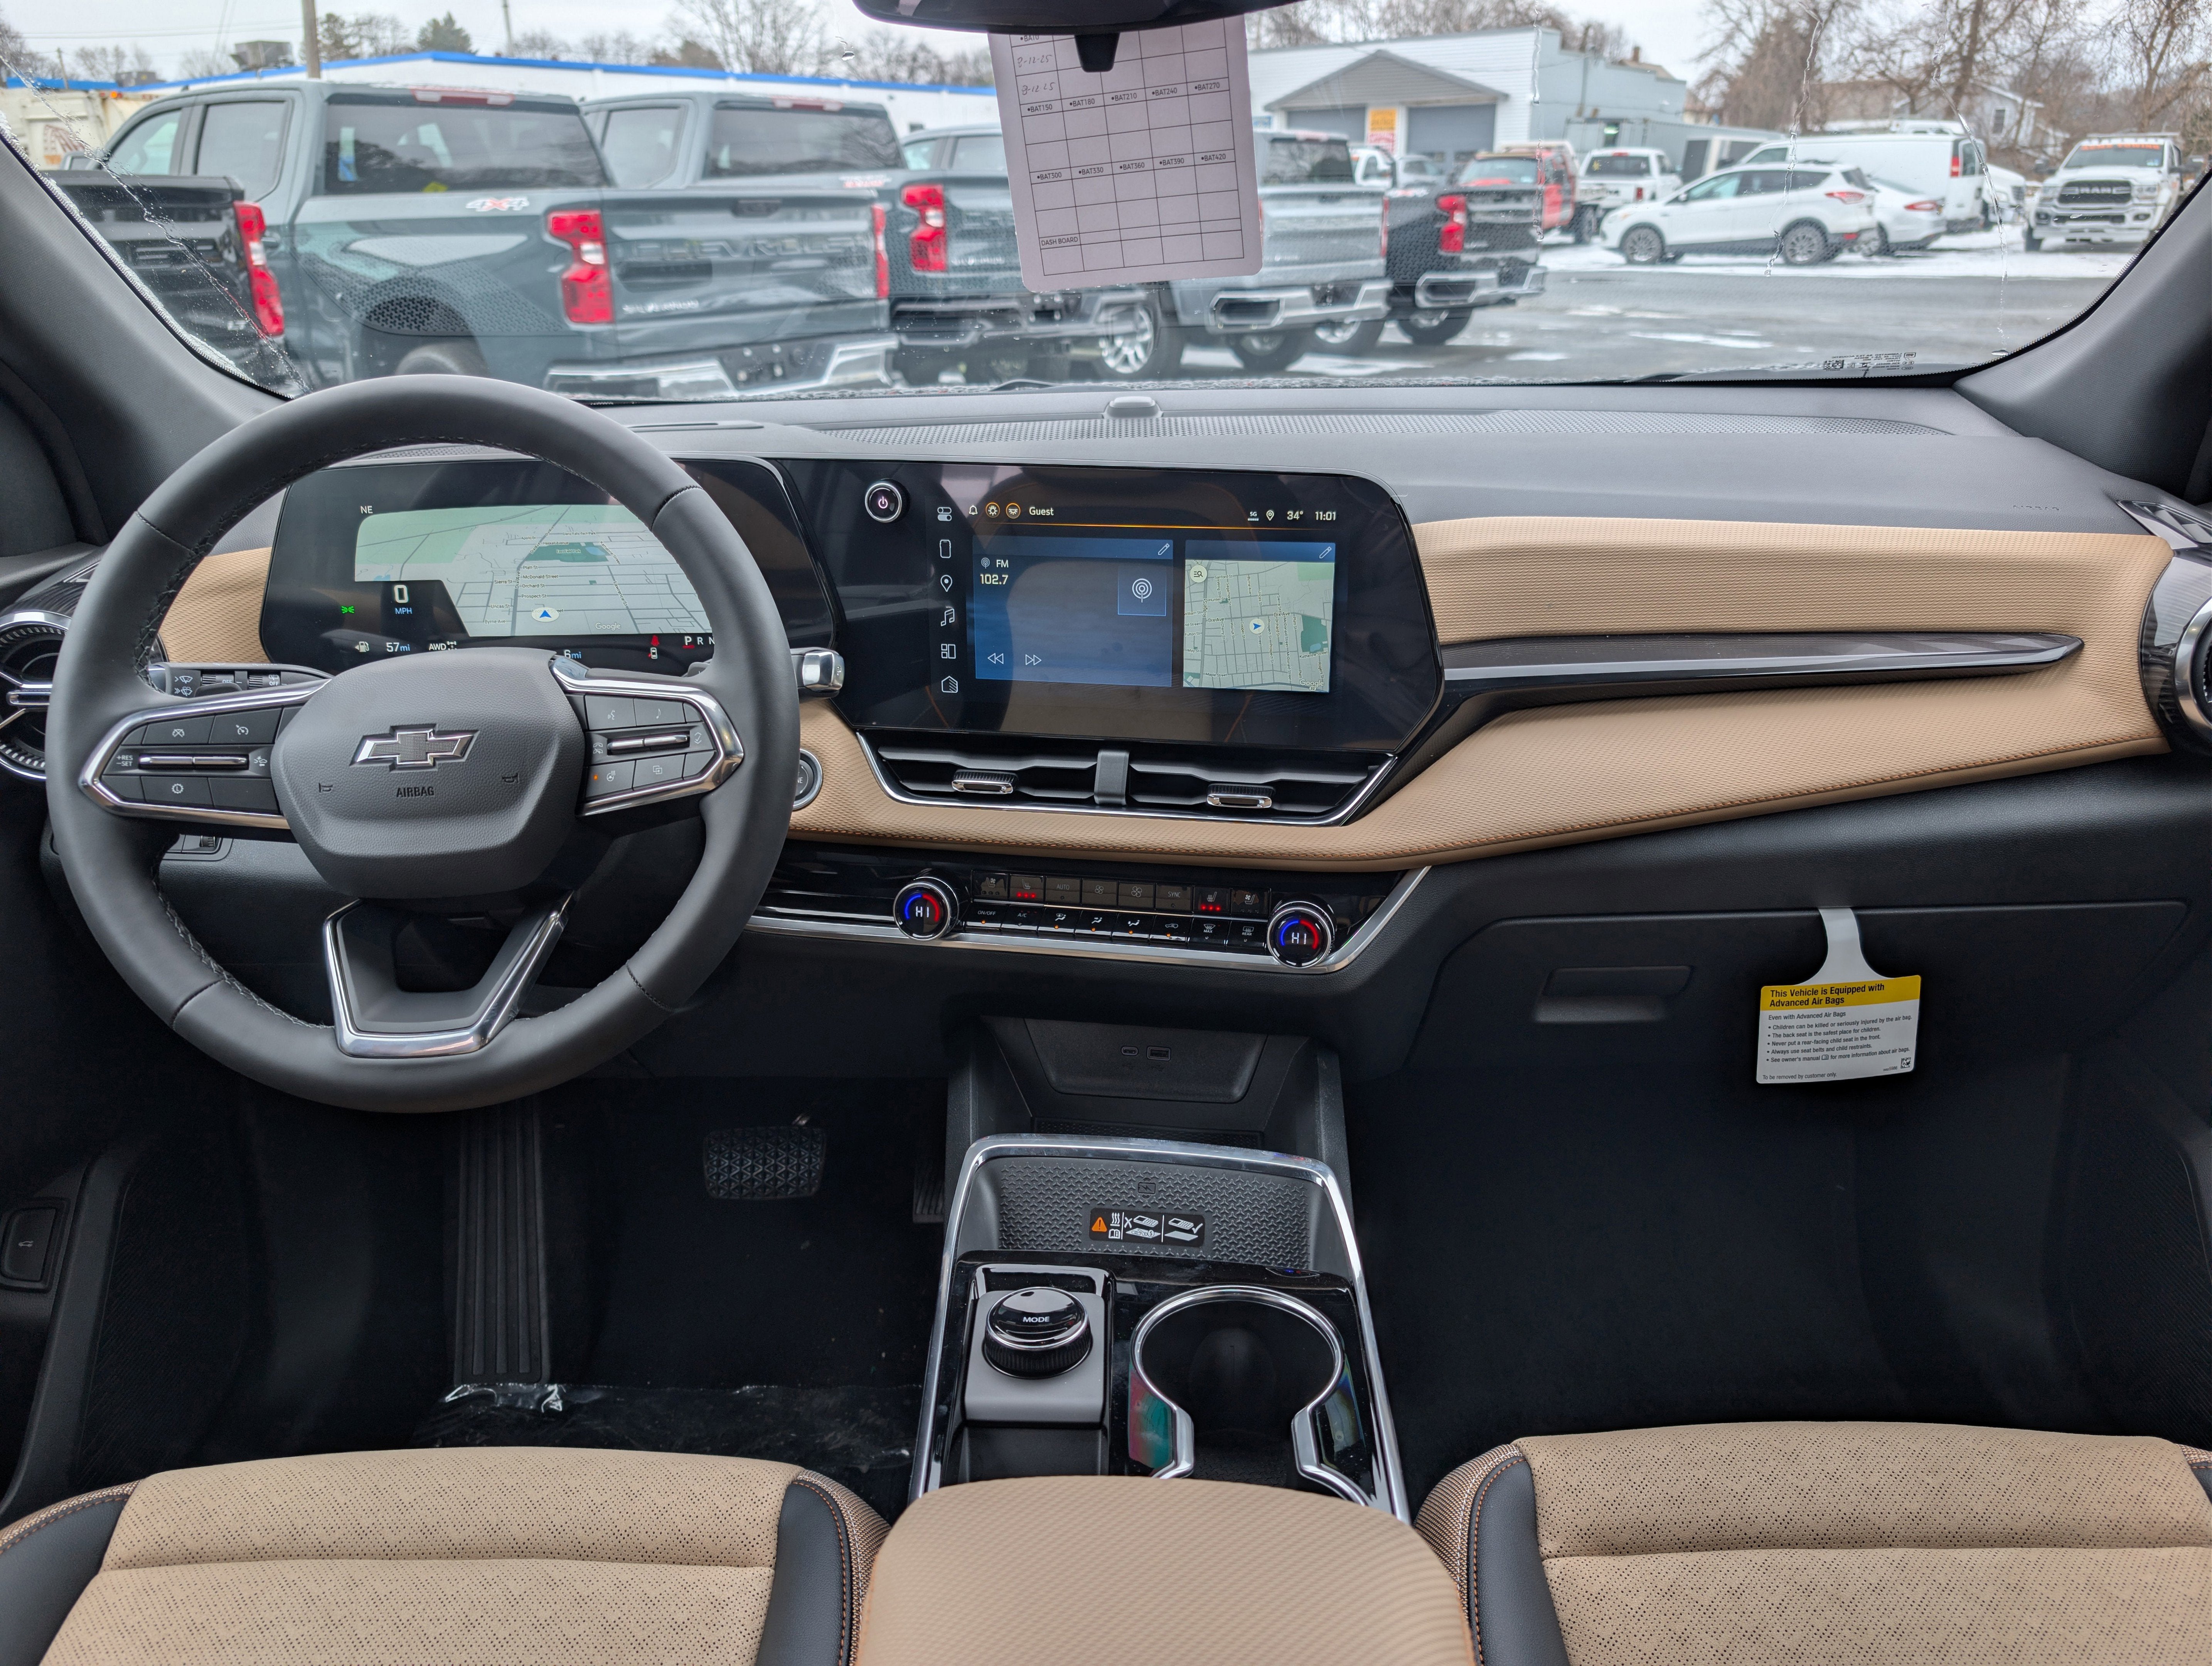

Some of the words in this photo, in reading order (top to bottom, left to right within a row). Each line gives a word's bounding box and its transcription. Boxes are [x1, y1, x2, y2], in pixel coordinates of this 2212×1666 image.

[361, 505, 373, 514] NE
[1029, 507, 1054, 516] Guest
[1315, 511, 1336, 521] 11:01
[996, 559, 1009, 568] FM
[980, 573, 1009, 585] 102.7
[394, 584, 409, 603] 0
[613, 581, 625, 602] Lawrence
[595, 622, 622, 631] Google
[685, 636, 692, 646] P
[697, 637, 704, 645] R
[1300, 679, 1324, 687] Google
[396, 786, 435, 798] AIRBAG
[1790, 988, 1819, 997] Vehicle
[1830, 985, 1866, 995] Equipped
[1868, 983, 1885, 992] with
[1770, 998, 1809, 1007] Advanced
[1825, 997, 1845, 1005] Bags
